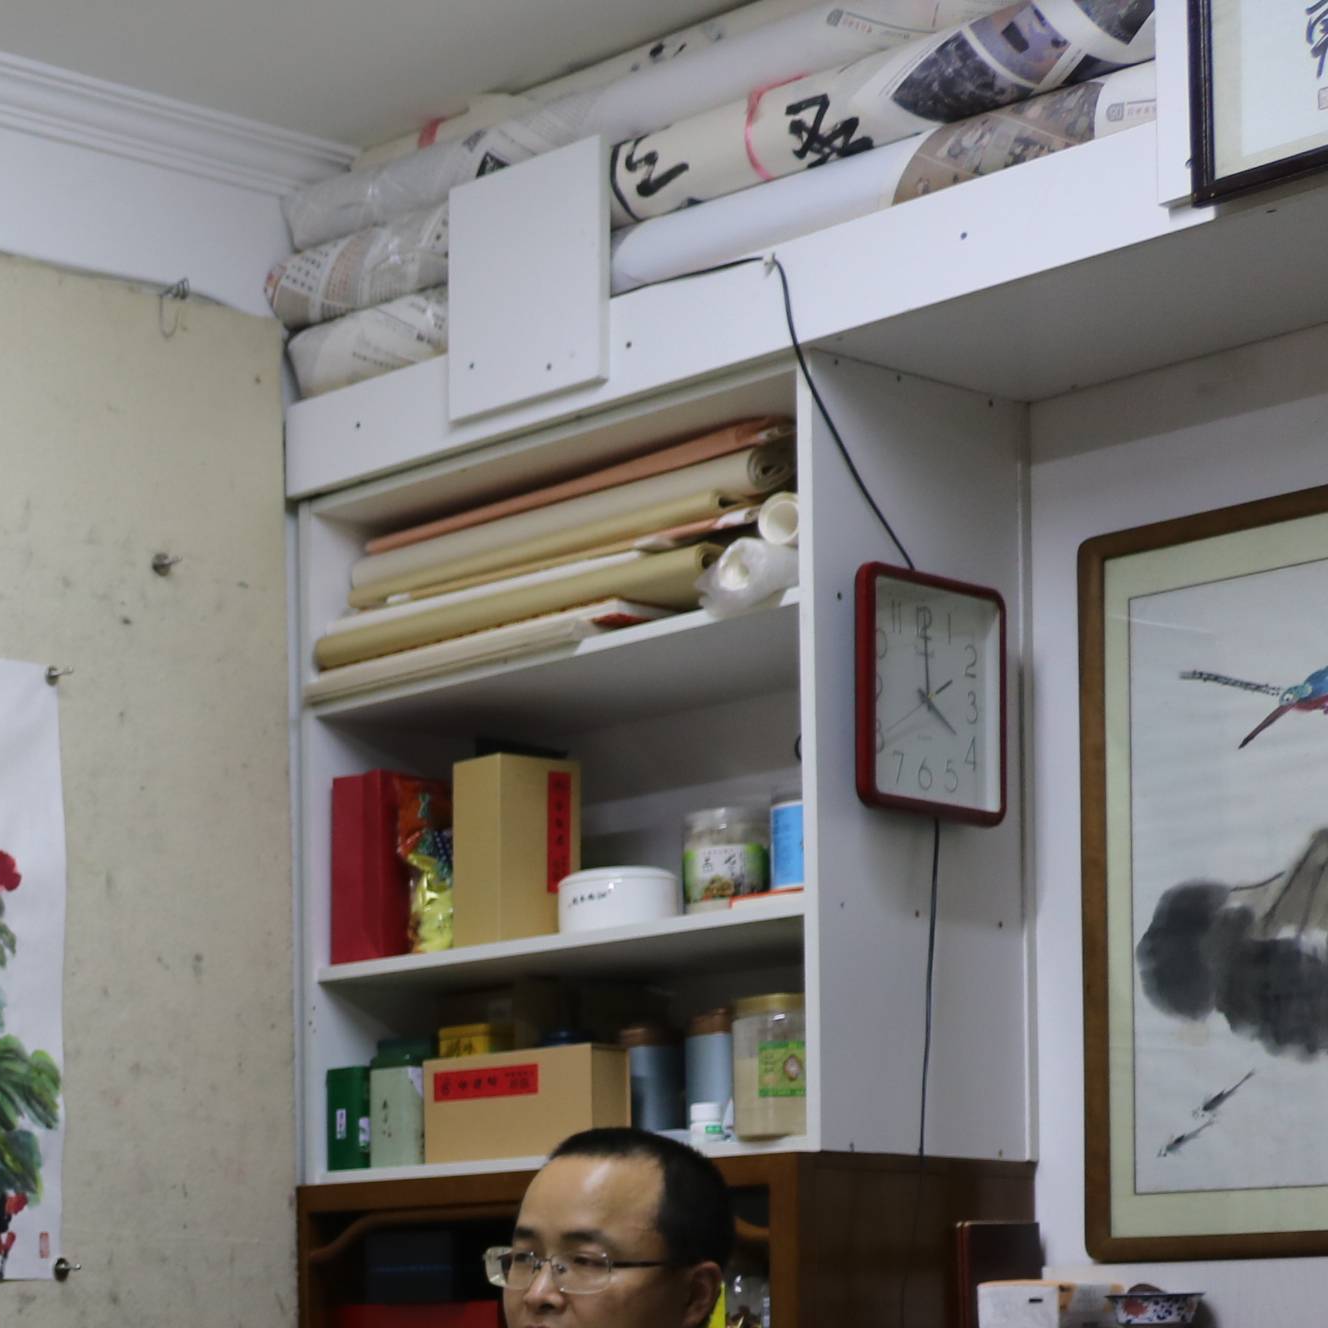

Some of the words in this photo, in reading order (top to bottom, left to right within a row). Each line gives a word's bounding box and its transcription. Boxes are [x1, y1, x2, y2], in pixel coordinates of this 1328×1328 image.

[964, 643, 978, 679] 2
[967, 690, 978, 726] 3
[963, 735, 977, 772] 4
[917, 757, 933, 791] 6
[944, 758, 958, 794] 5
